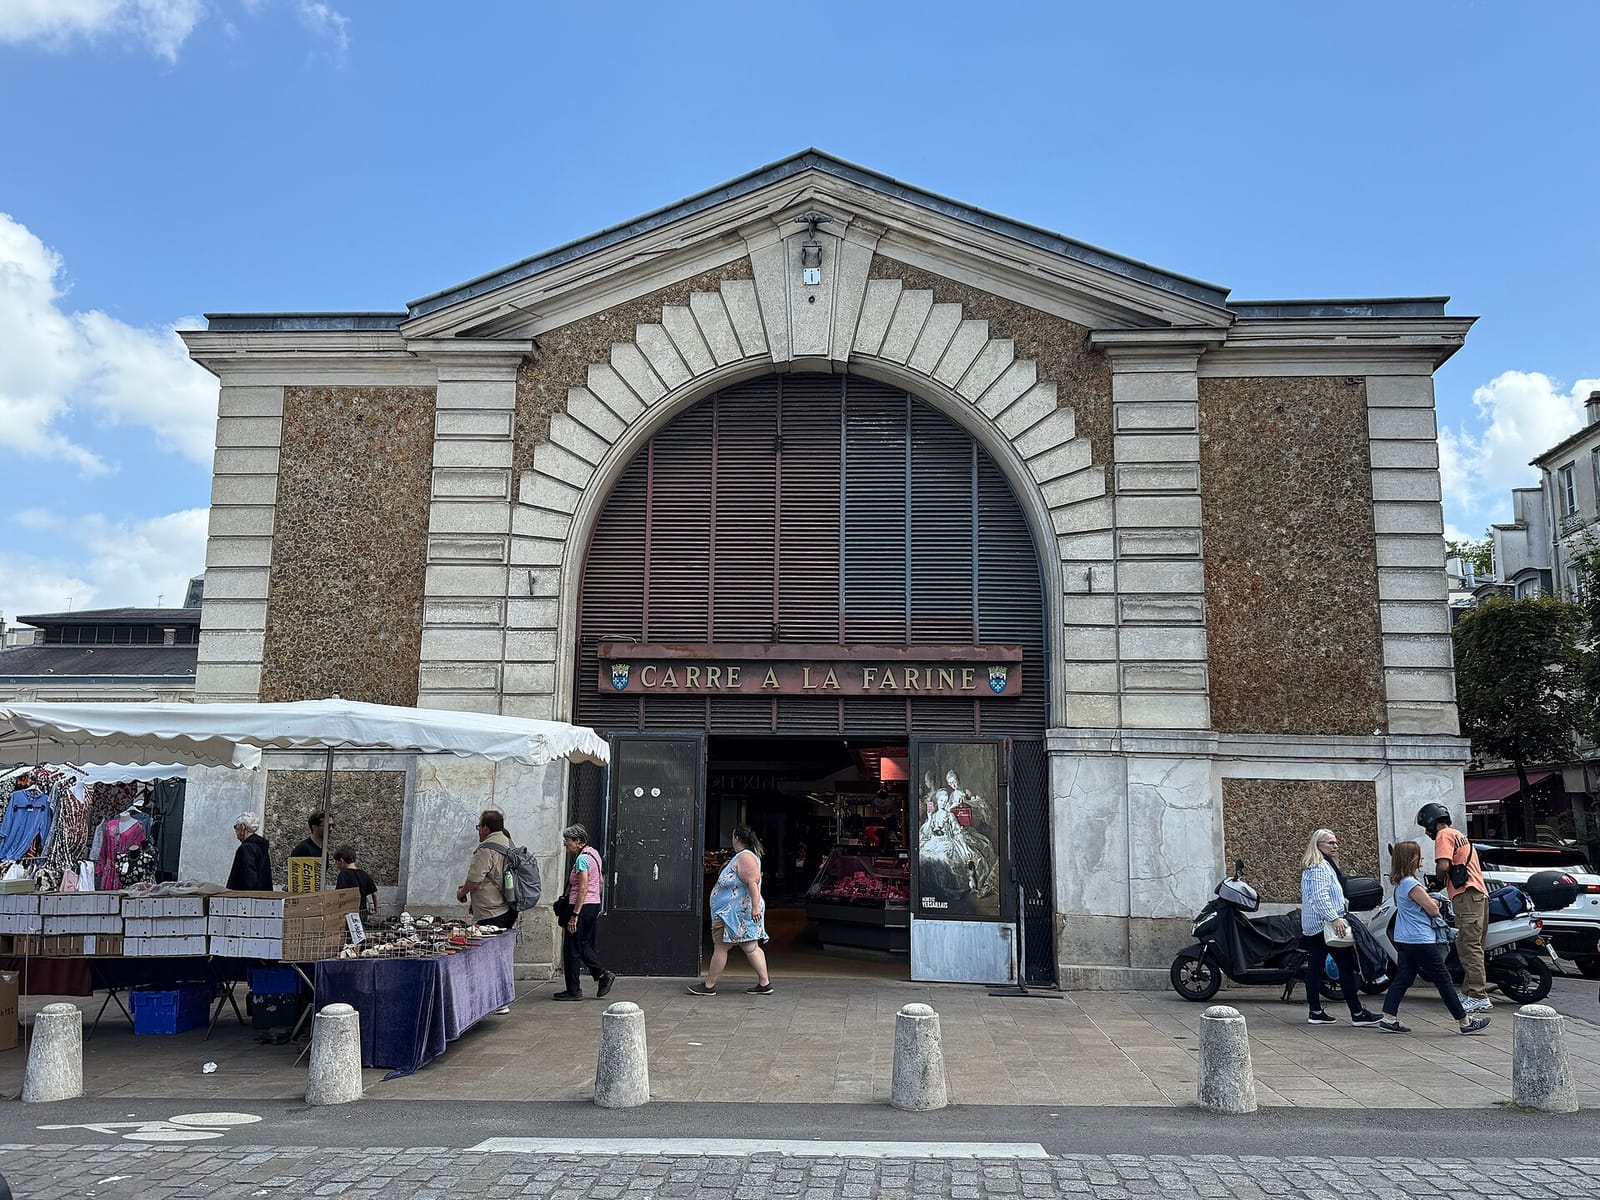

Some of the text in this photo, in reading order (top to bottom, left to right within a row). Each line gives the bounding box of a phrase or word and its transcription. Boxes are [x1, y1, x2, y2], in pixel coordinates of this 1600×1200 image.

[640, 665, 977, 690] CARRE A LA FARINE
[313, 860, 322, 893] Marchan
